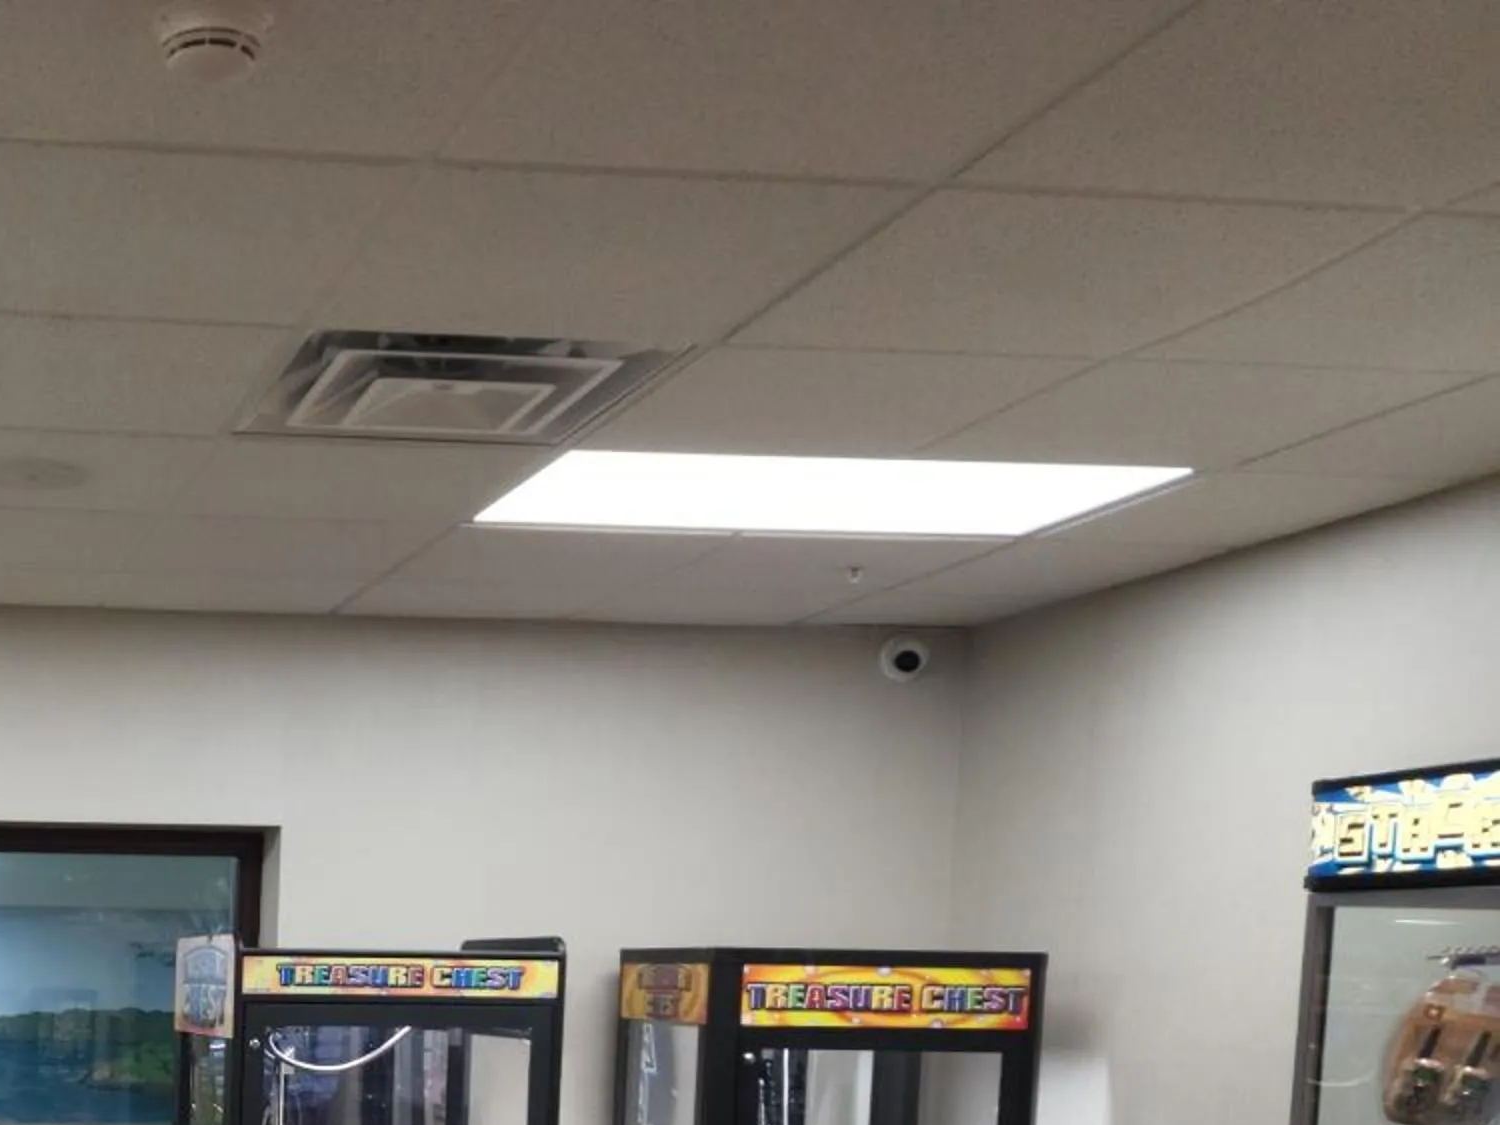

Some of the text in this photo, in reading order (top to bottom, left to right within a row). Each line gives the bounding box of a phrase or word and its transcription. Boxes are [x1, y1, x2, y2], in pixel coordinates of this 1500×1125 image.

[277, 963, 526, 990] TREASURE CHEST
[746, 982, 1028, 1014] TREASURE CHEST
